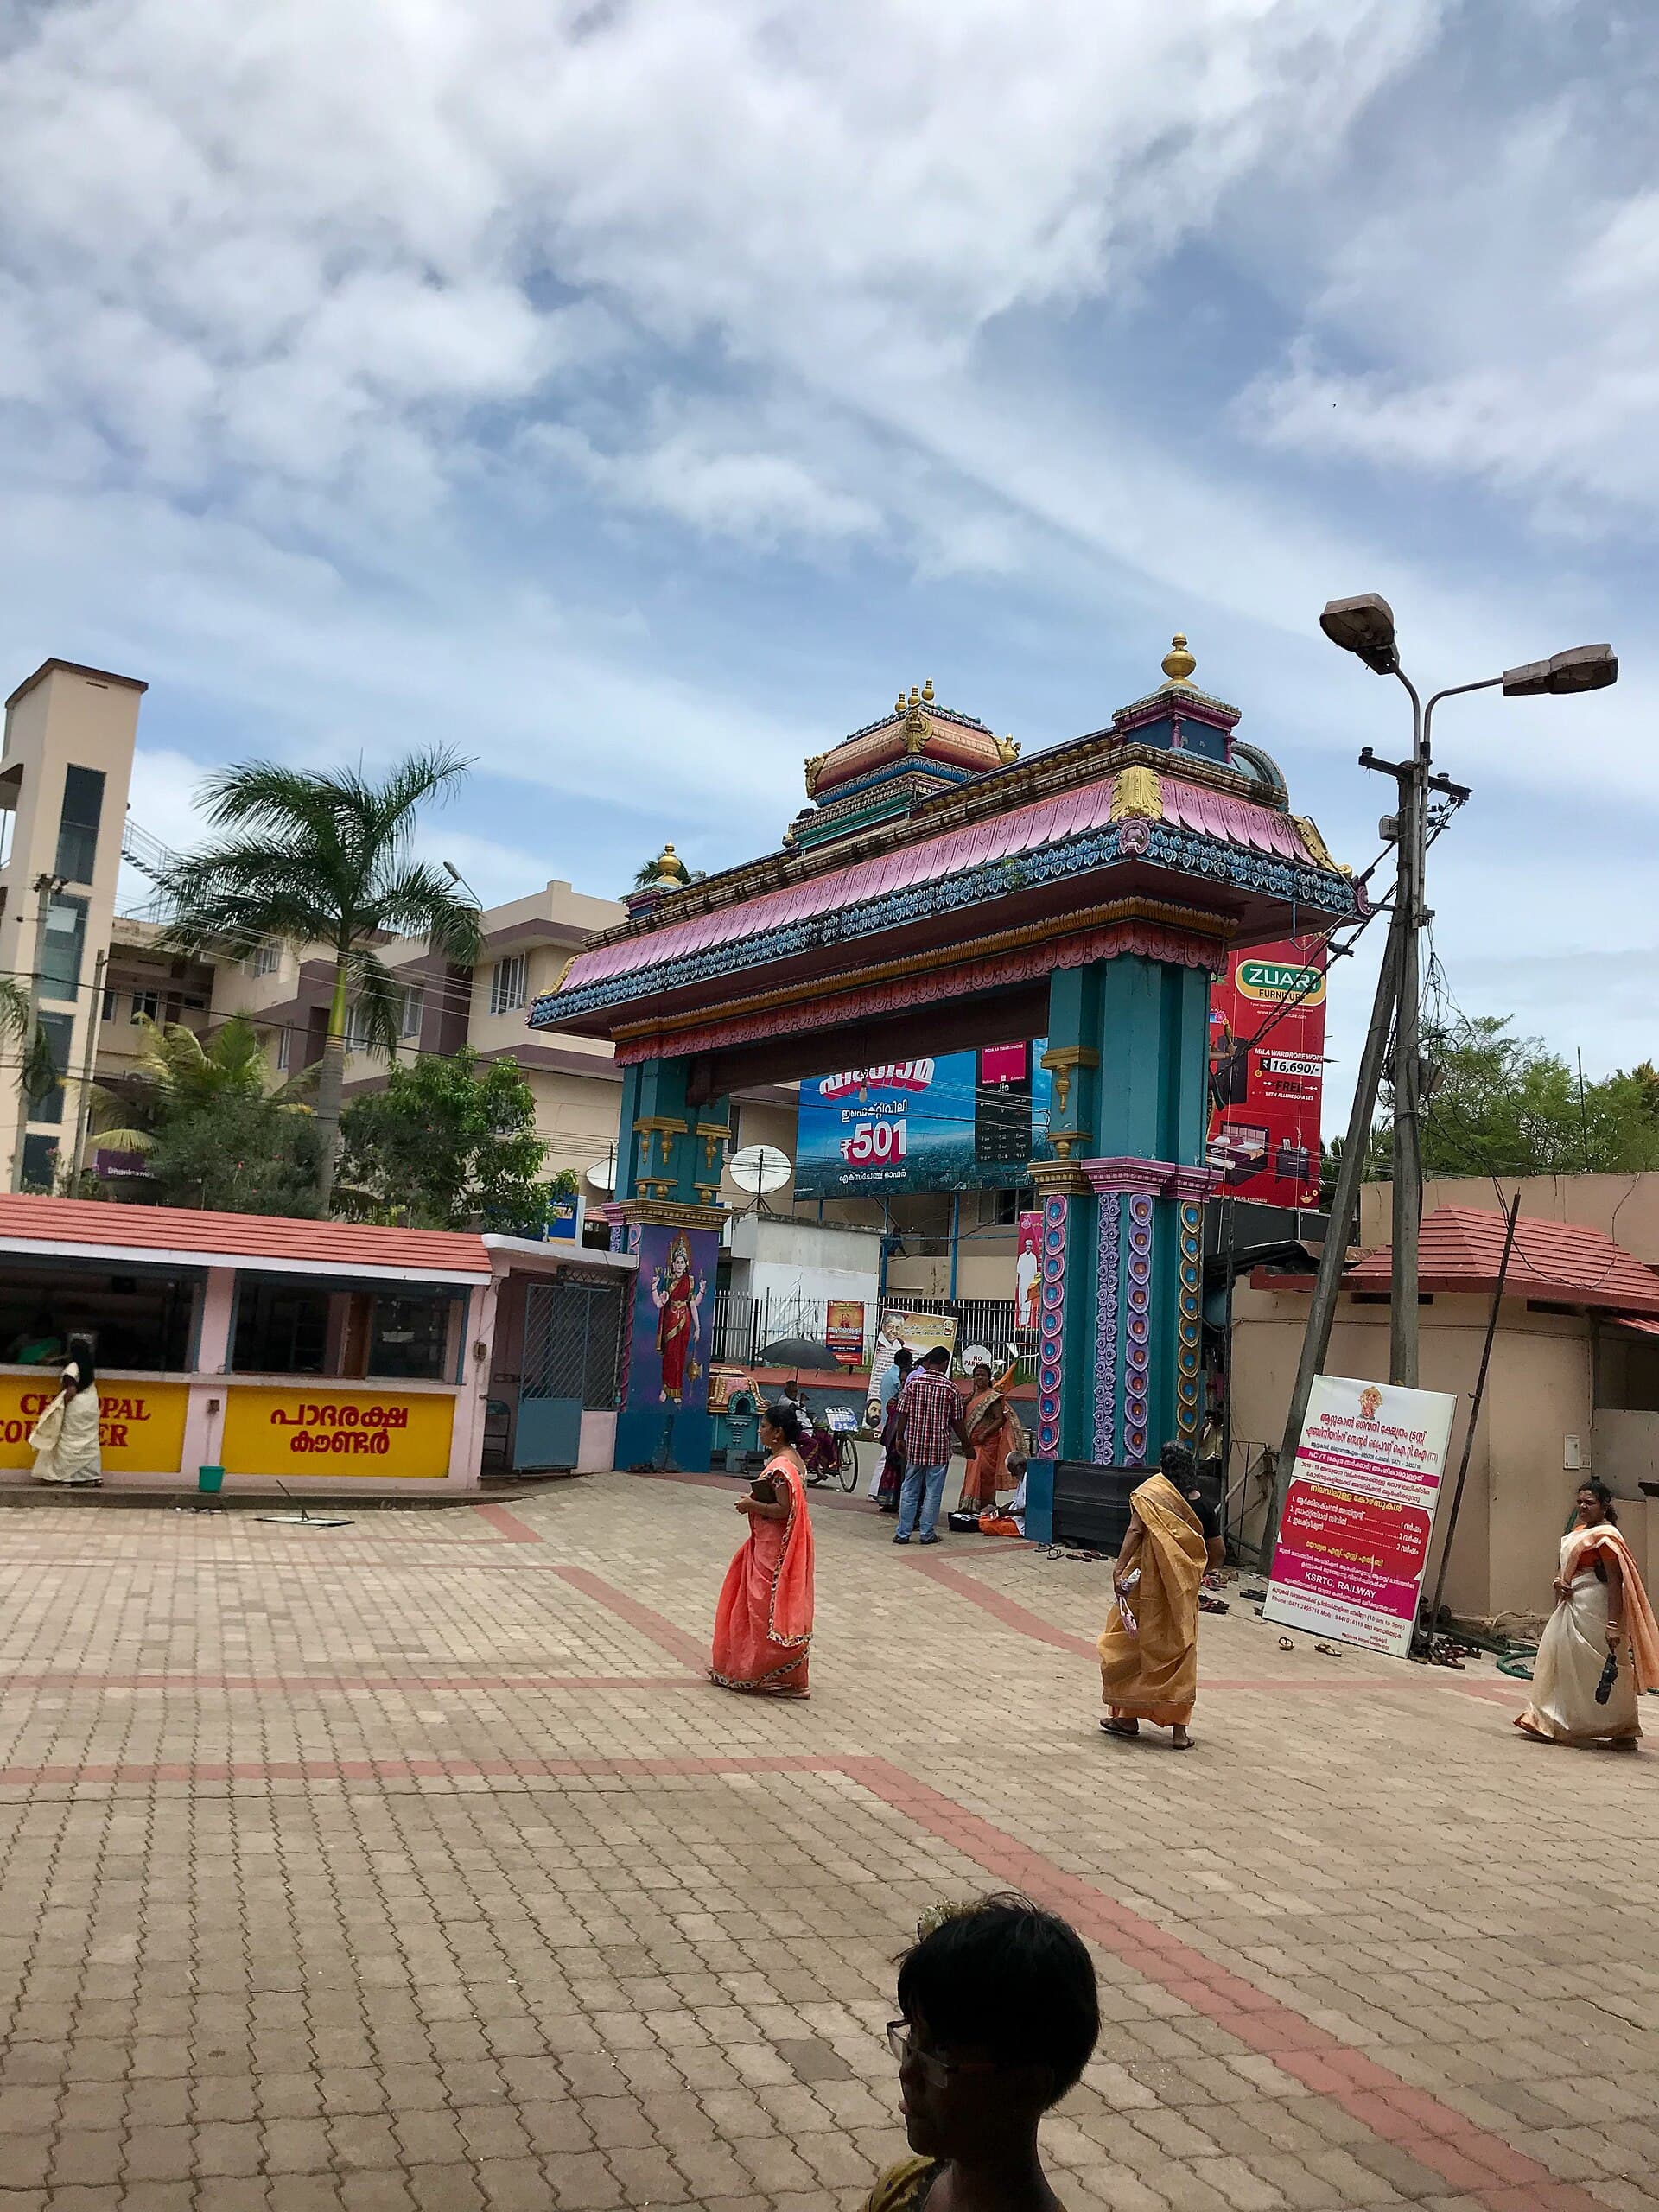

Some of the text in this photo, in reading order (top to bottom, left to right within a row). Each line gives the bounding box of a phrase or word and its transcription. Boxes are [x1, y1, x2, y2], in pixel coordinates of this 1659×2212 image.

[1249, 968, 1317, 989] ZUARI
[1259, 988, 1306, 1002] FURNITURE
[1271, 1050, 1306, 1060] WARDROBE
[1273, 1060, 1319, 1074] 16,690/-
[1275, 1079, 1303, 1092] FREE
[270, 1403, 409, 1428] പാദരക്ഷ
[1308, 1451, 1325, 1459] NCVT
[1305, 1572, 1376, 1597] KSRTC, RAILWAY
